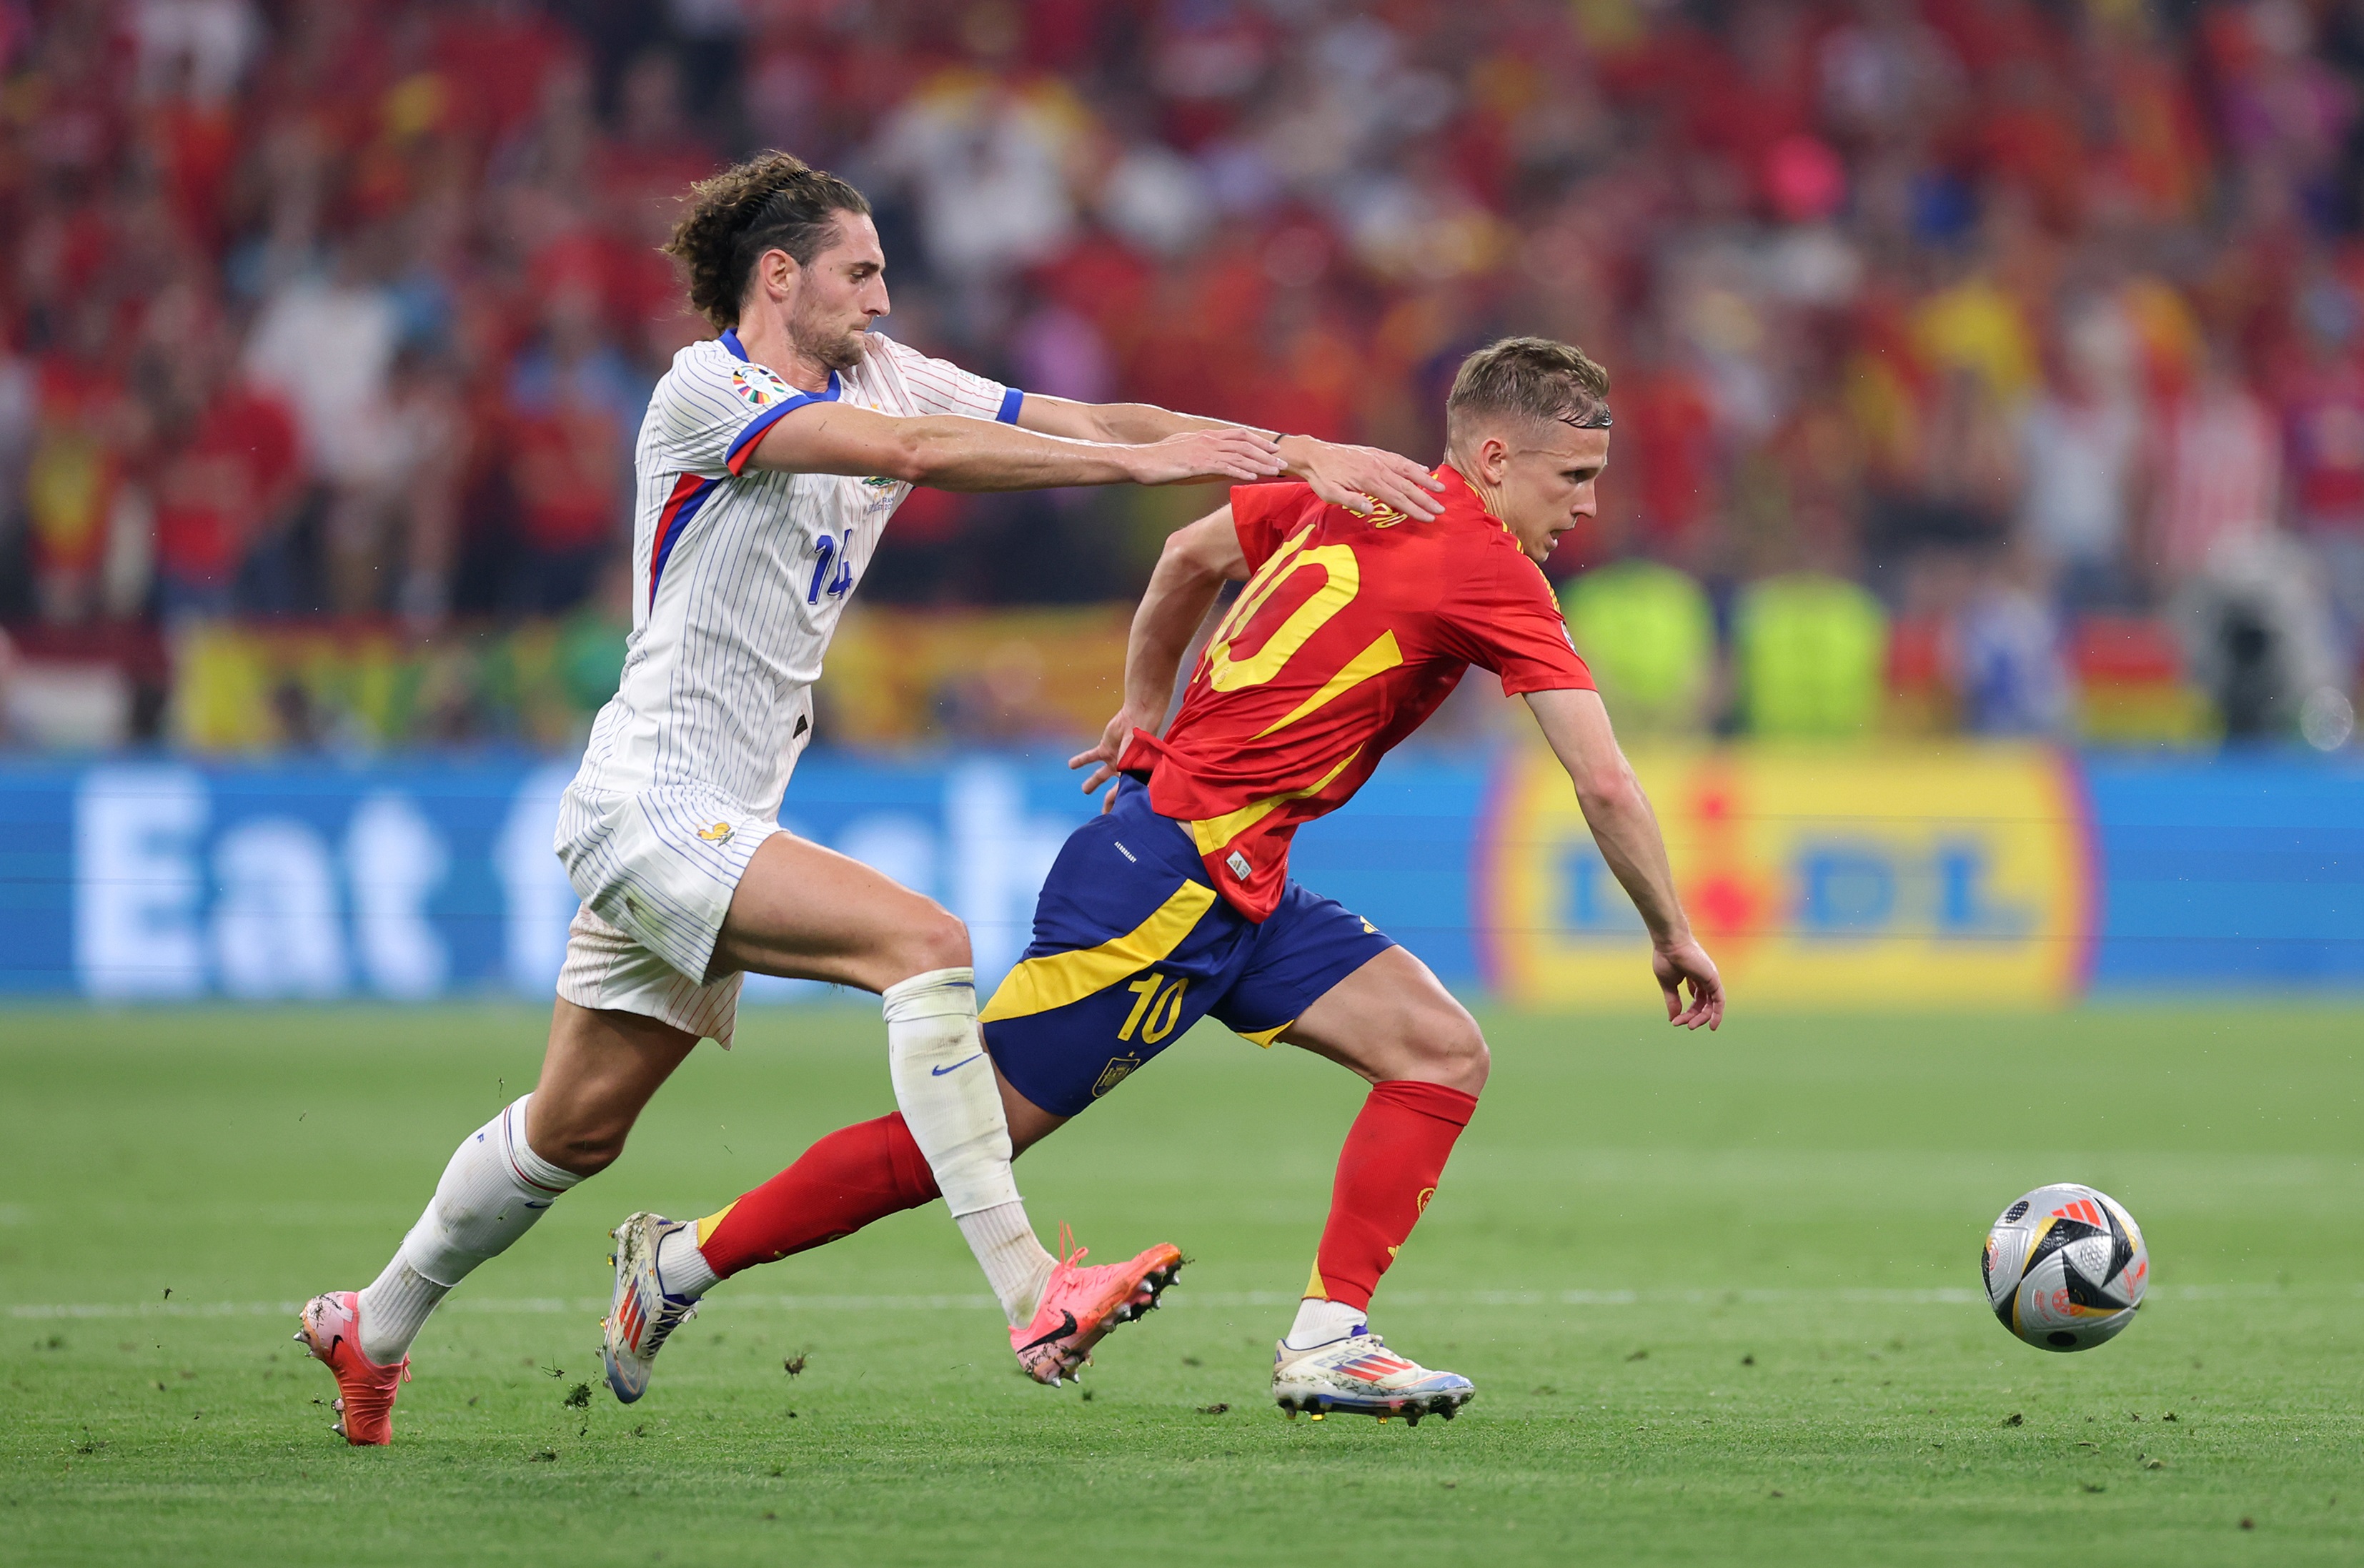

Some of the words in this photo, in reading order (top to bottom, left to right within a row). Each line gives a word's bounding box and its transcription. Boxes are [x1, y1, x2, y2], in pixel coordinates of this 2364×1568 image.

[807, 527, 853, 605] 14
[1193, 523, 1361, 693] 10
[74, 765, 445, 996] Eat
[1117, 972, 1190, 1044] 10
[1313, 1348, 1366, 1368] F50
